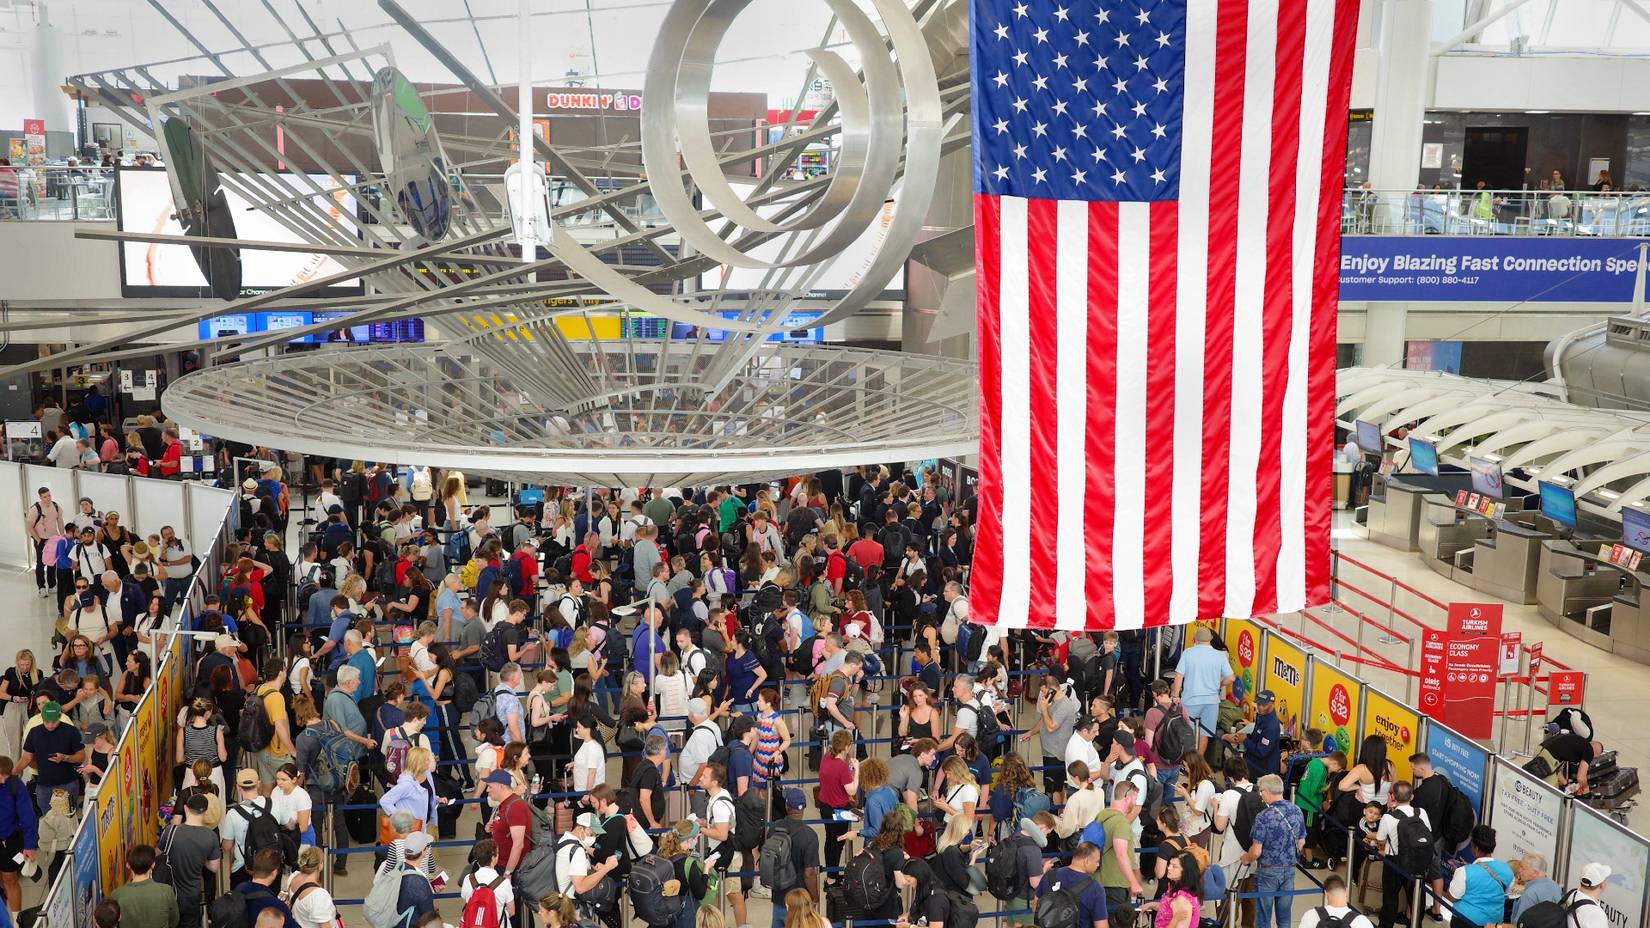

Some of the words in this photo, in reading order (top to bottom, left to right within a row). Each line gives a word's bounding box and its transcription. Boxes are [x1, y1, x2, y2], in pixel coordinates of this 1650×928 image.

[1340, 254, 1389, 274] Enjoy
[1393, 254, 1458, 274] Blazing
[1461, 255, 1500, 271] Fast
[1503, 255, 1602, 272] Connection
[1338, 276, 1376, 284] ustomer
[1378, 276, 1414, 285] Support:
[1416, 276, 1440, 285] (800)
[1442, 276, 1479, 284] 880-4117
[30, 425, 38, 436] 4
[193, 439, 200, 447] 2
[1330, 700, 1349, 719] $32
[1375, 714, 1400, 737] enjoy
[1522, 784, 1543, 803] BEAUTY
[1600, 900, 1628, 928] EAUTY
